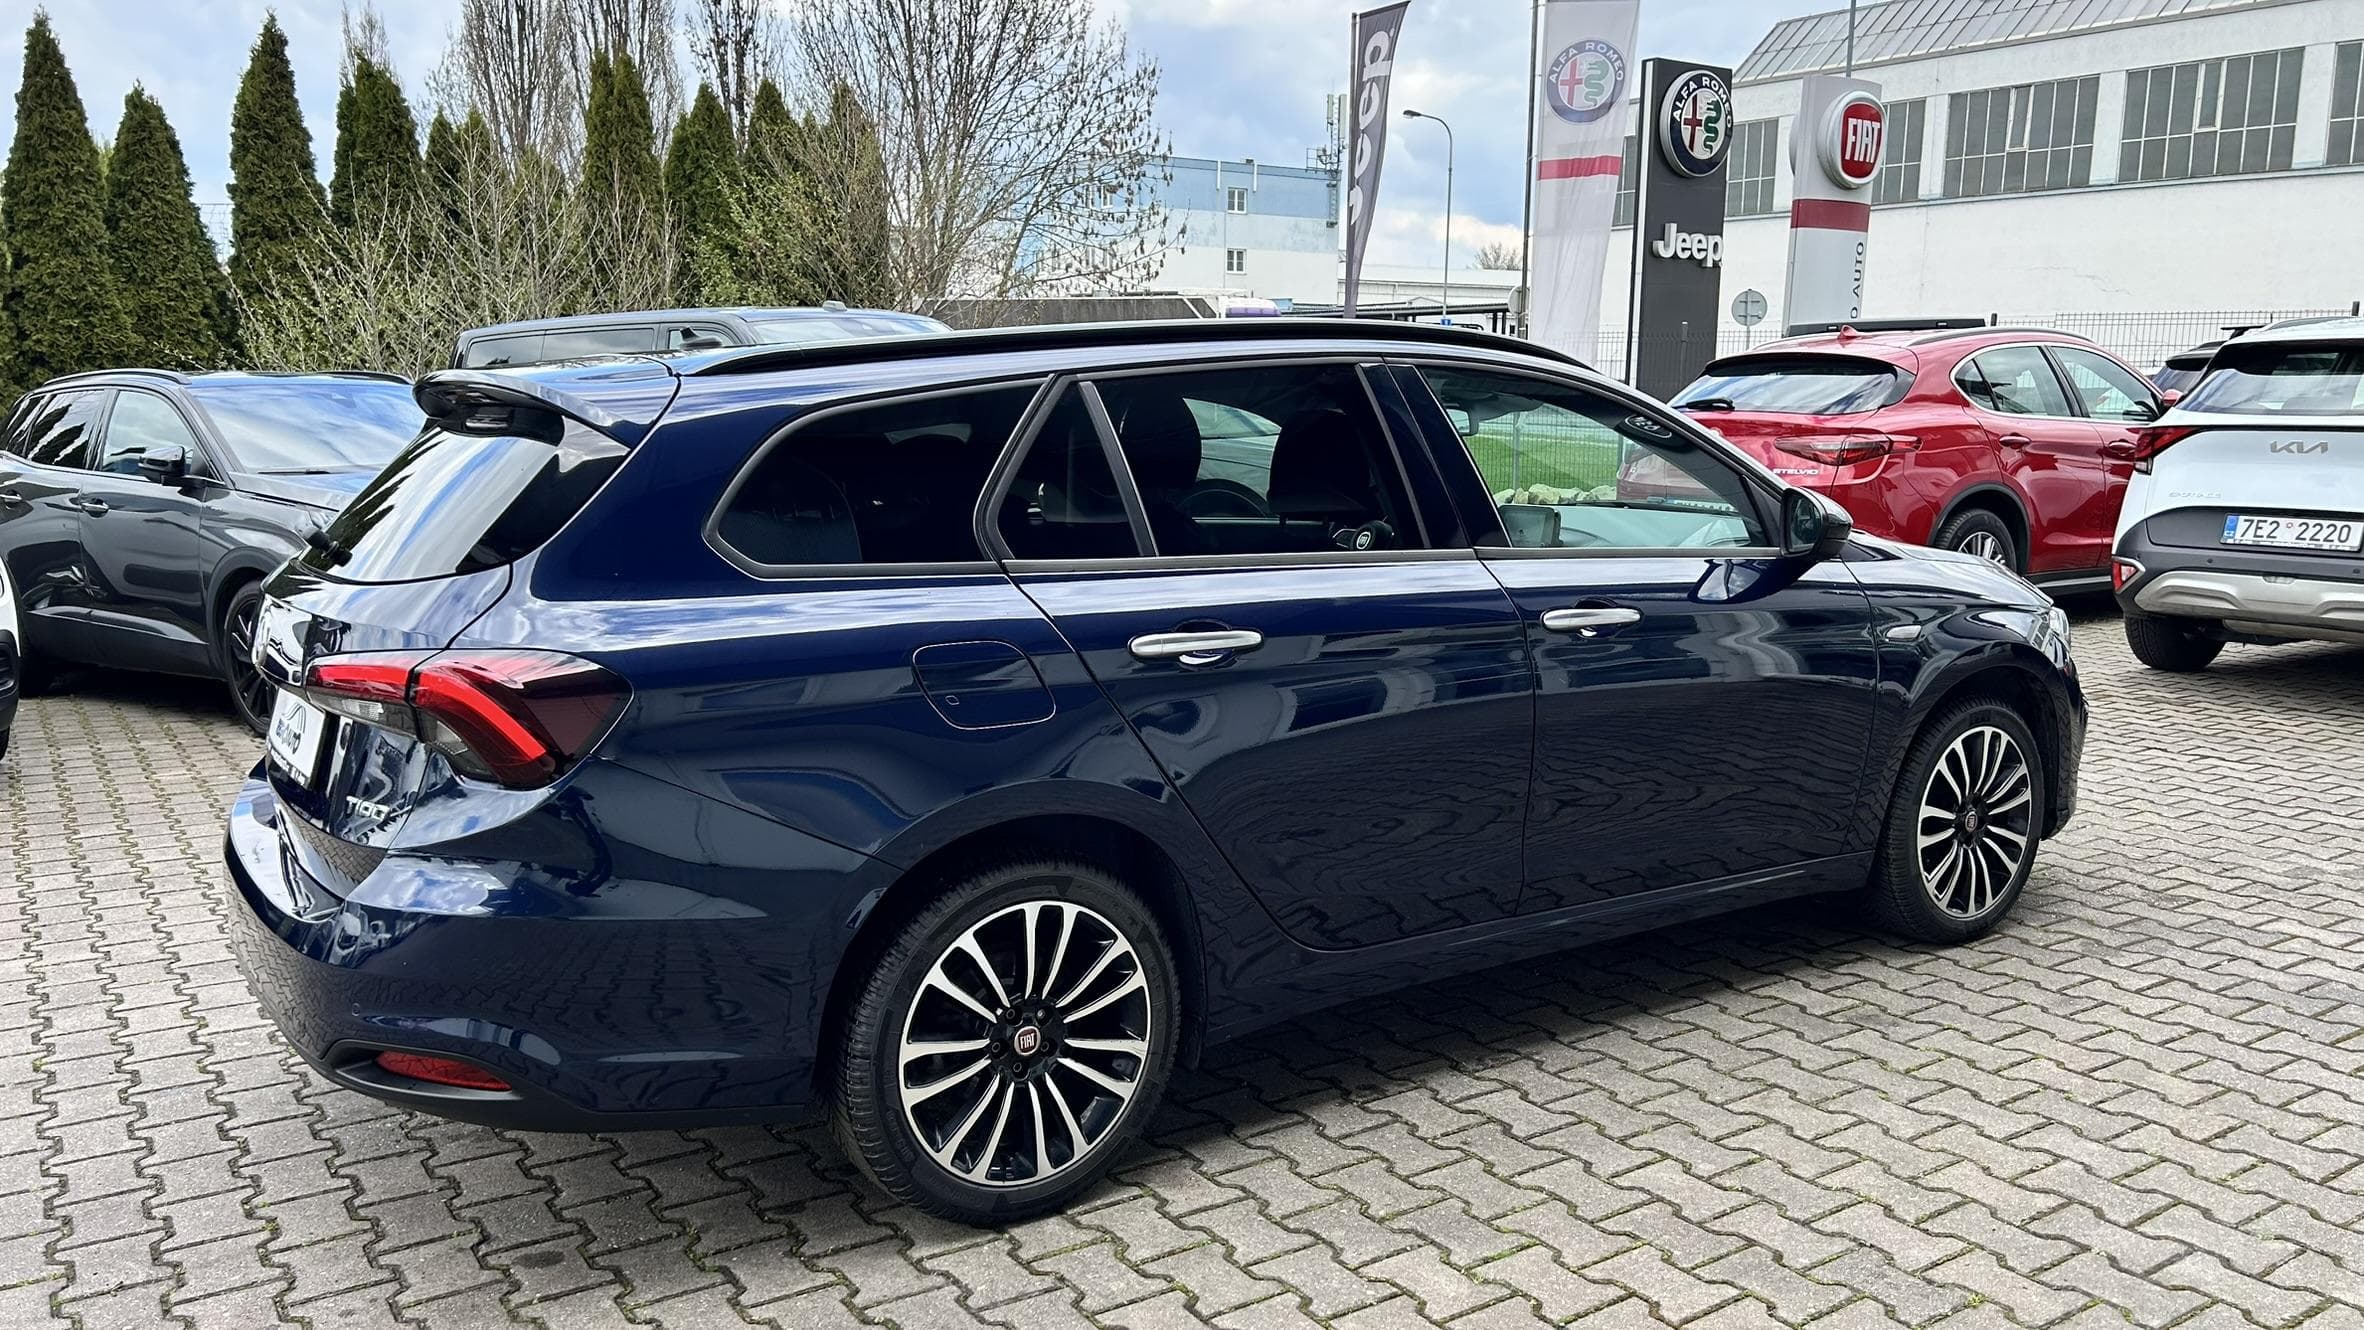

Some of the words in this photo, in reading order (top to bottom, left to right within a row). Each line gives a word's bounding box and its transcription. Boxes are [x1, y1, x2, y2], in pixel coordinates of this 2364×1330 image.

[1549, 47, 1578, 83] ALFA
[1585, 42, 1624, 81] ROMEO
[1673, 81, 1698, 122] ALFA
[1702, 76, 1732, 128] ROMEO
[1845, 117, 1881, 163] FIAT
[1652, 222, 1724, 268] Jeep
[1852, 241, 1865, 298] AUTO
[2240, 519, 2280, 539] 7E2
[2294, 522, 2352, 543] 2220
[1020, 1032, 1035, 1049] FIAT
